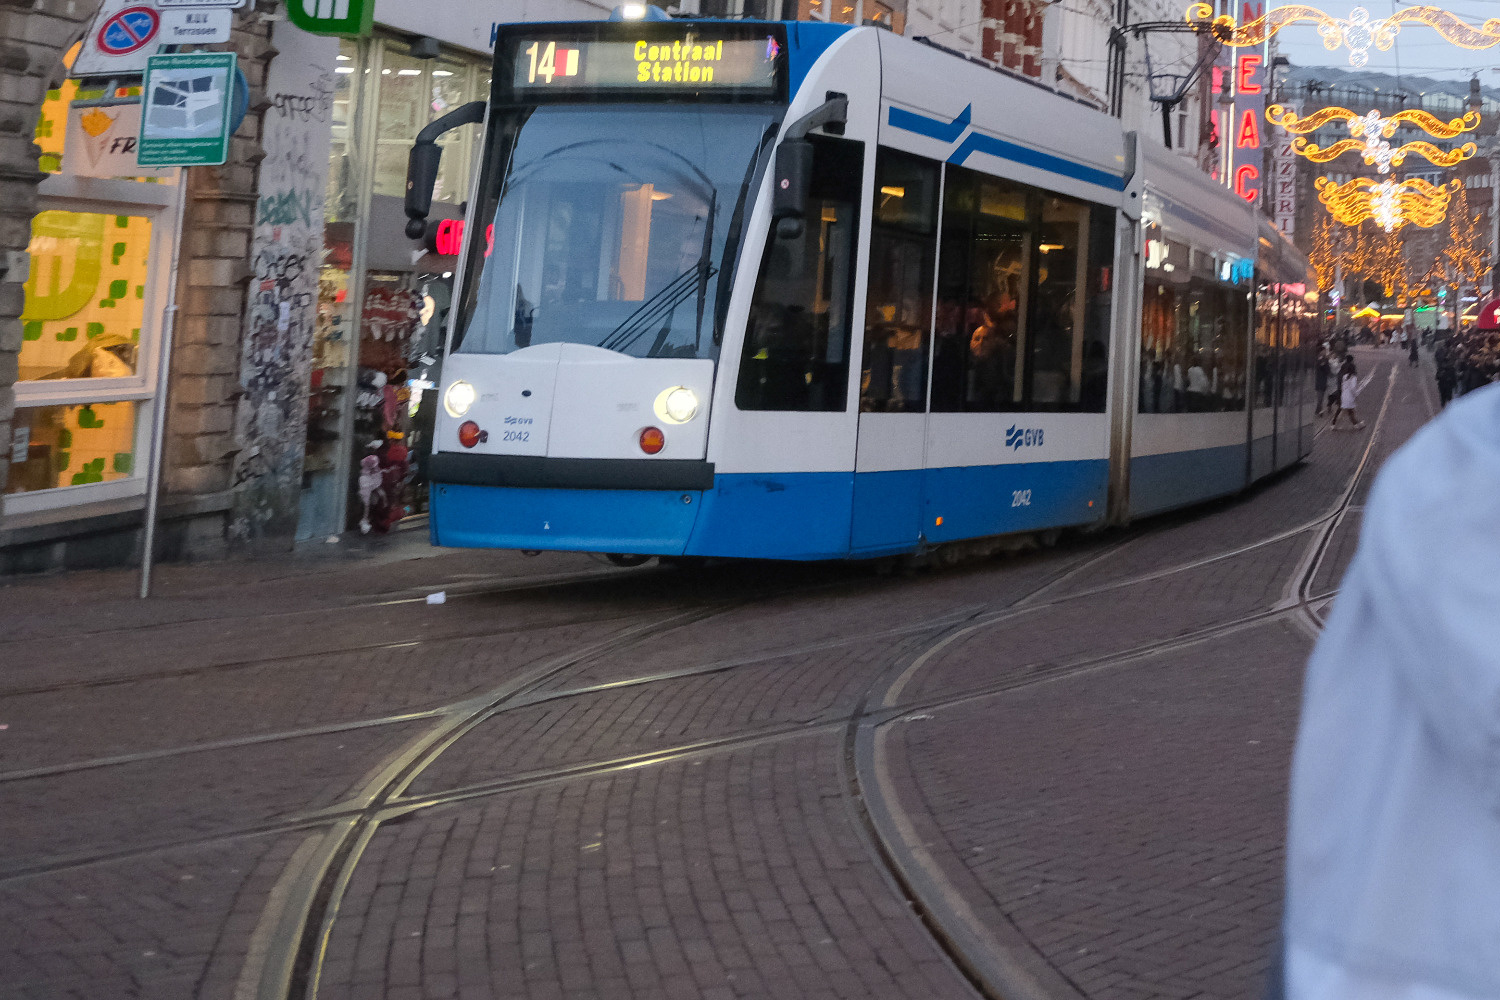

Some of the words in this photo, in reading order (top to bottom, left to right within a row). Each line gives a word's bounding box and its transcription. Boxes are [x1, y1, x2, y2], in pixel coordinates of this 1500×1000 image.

[634, 40, 723, 63] Centraal
[526, 41, 556, 84] 14
[637, 62, 714, 83] Station
[109, 136, 137, 154] FR
[503, 431, 530, 442] 2042
[1025, 428, 1044, 447] GVB
[1011, 489, 1032, 507] 2042
